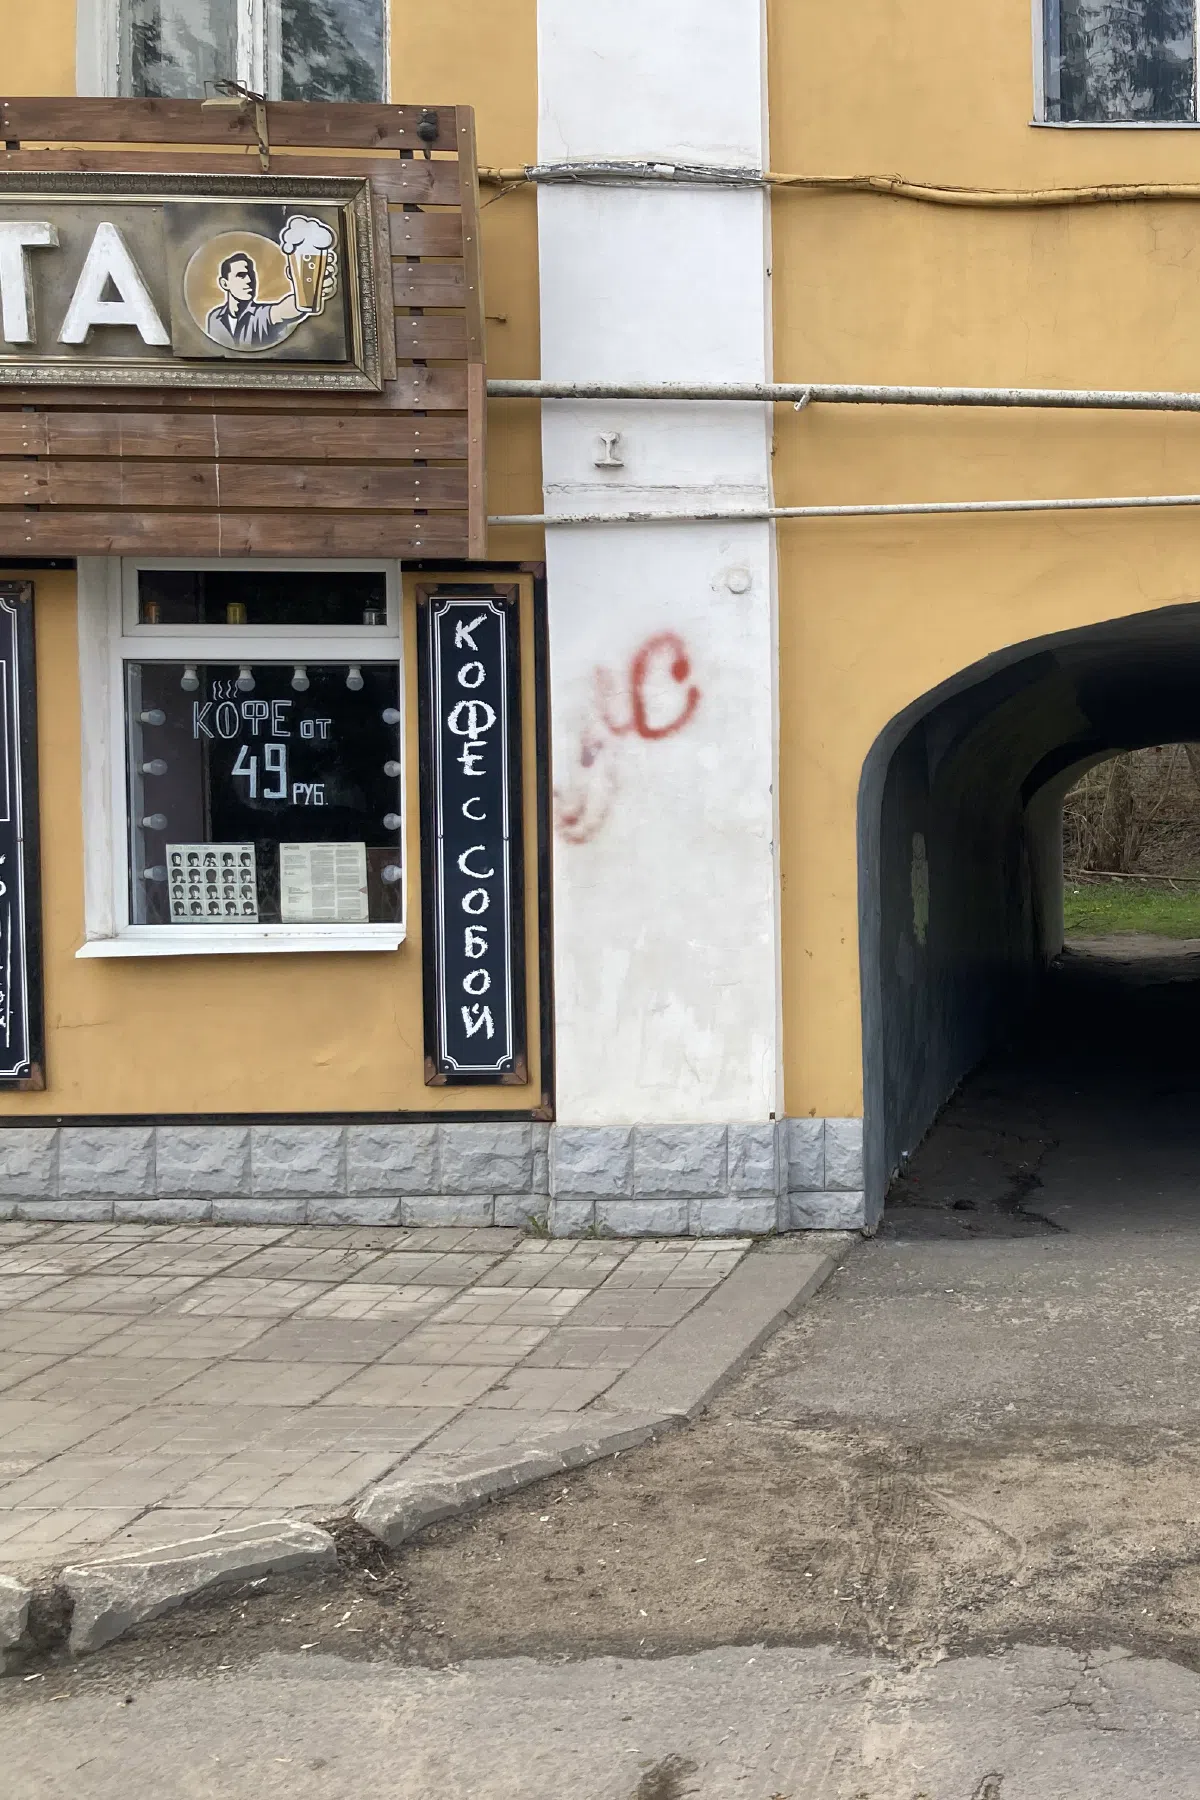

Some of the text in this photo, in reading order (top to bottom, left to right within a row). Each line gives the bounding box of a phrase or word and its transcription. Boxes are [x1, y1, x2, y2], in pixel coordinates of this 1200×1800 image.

[193, 700, 292, 739] КОФЕ
[231, 743, 287, 799] 49
[448, 613, 497, 1040] КОФЕ С СОБОЙ
